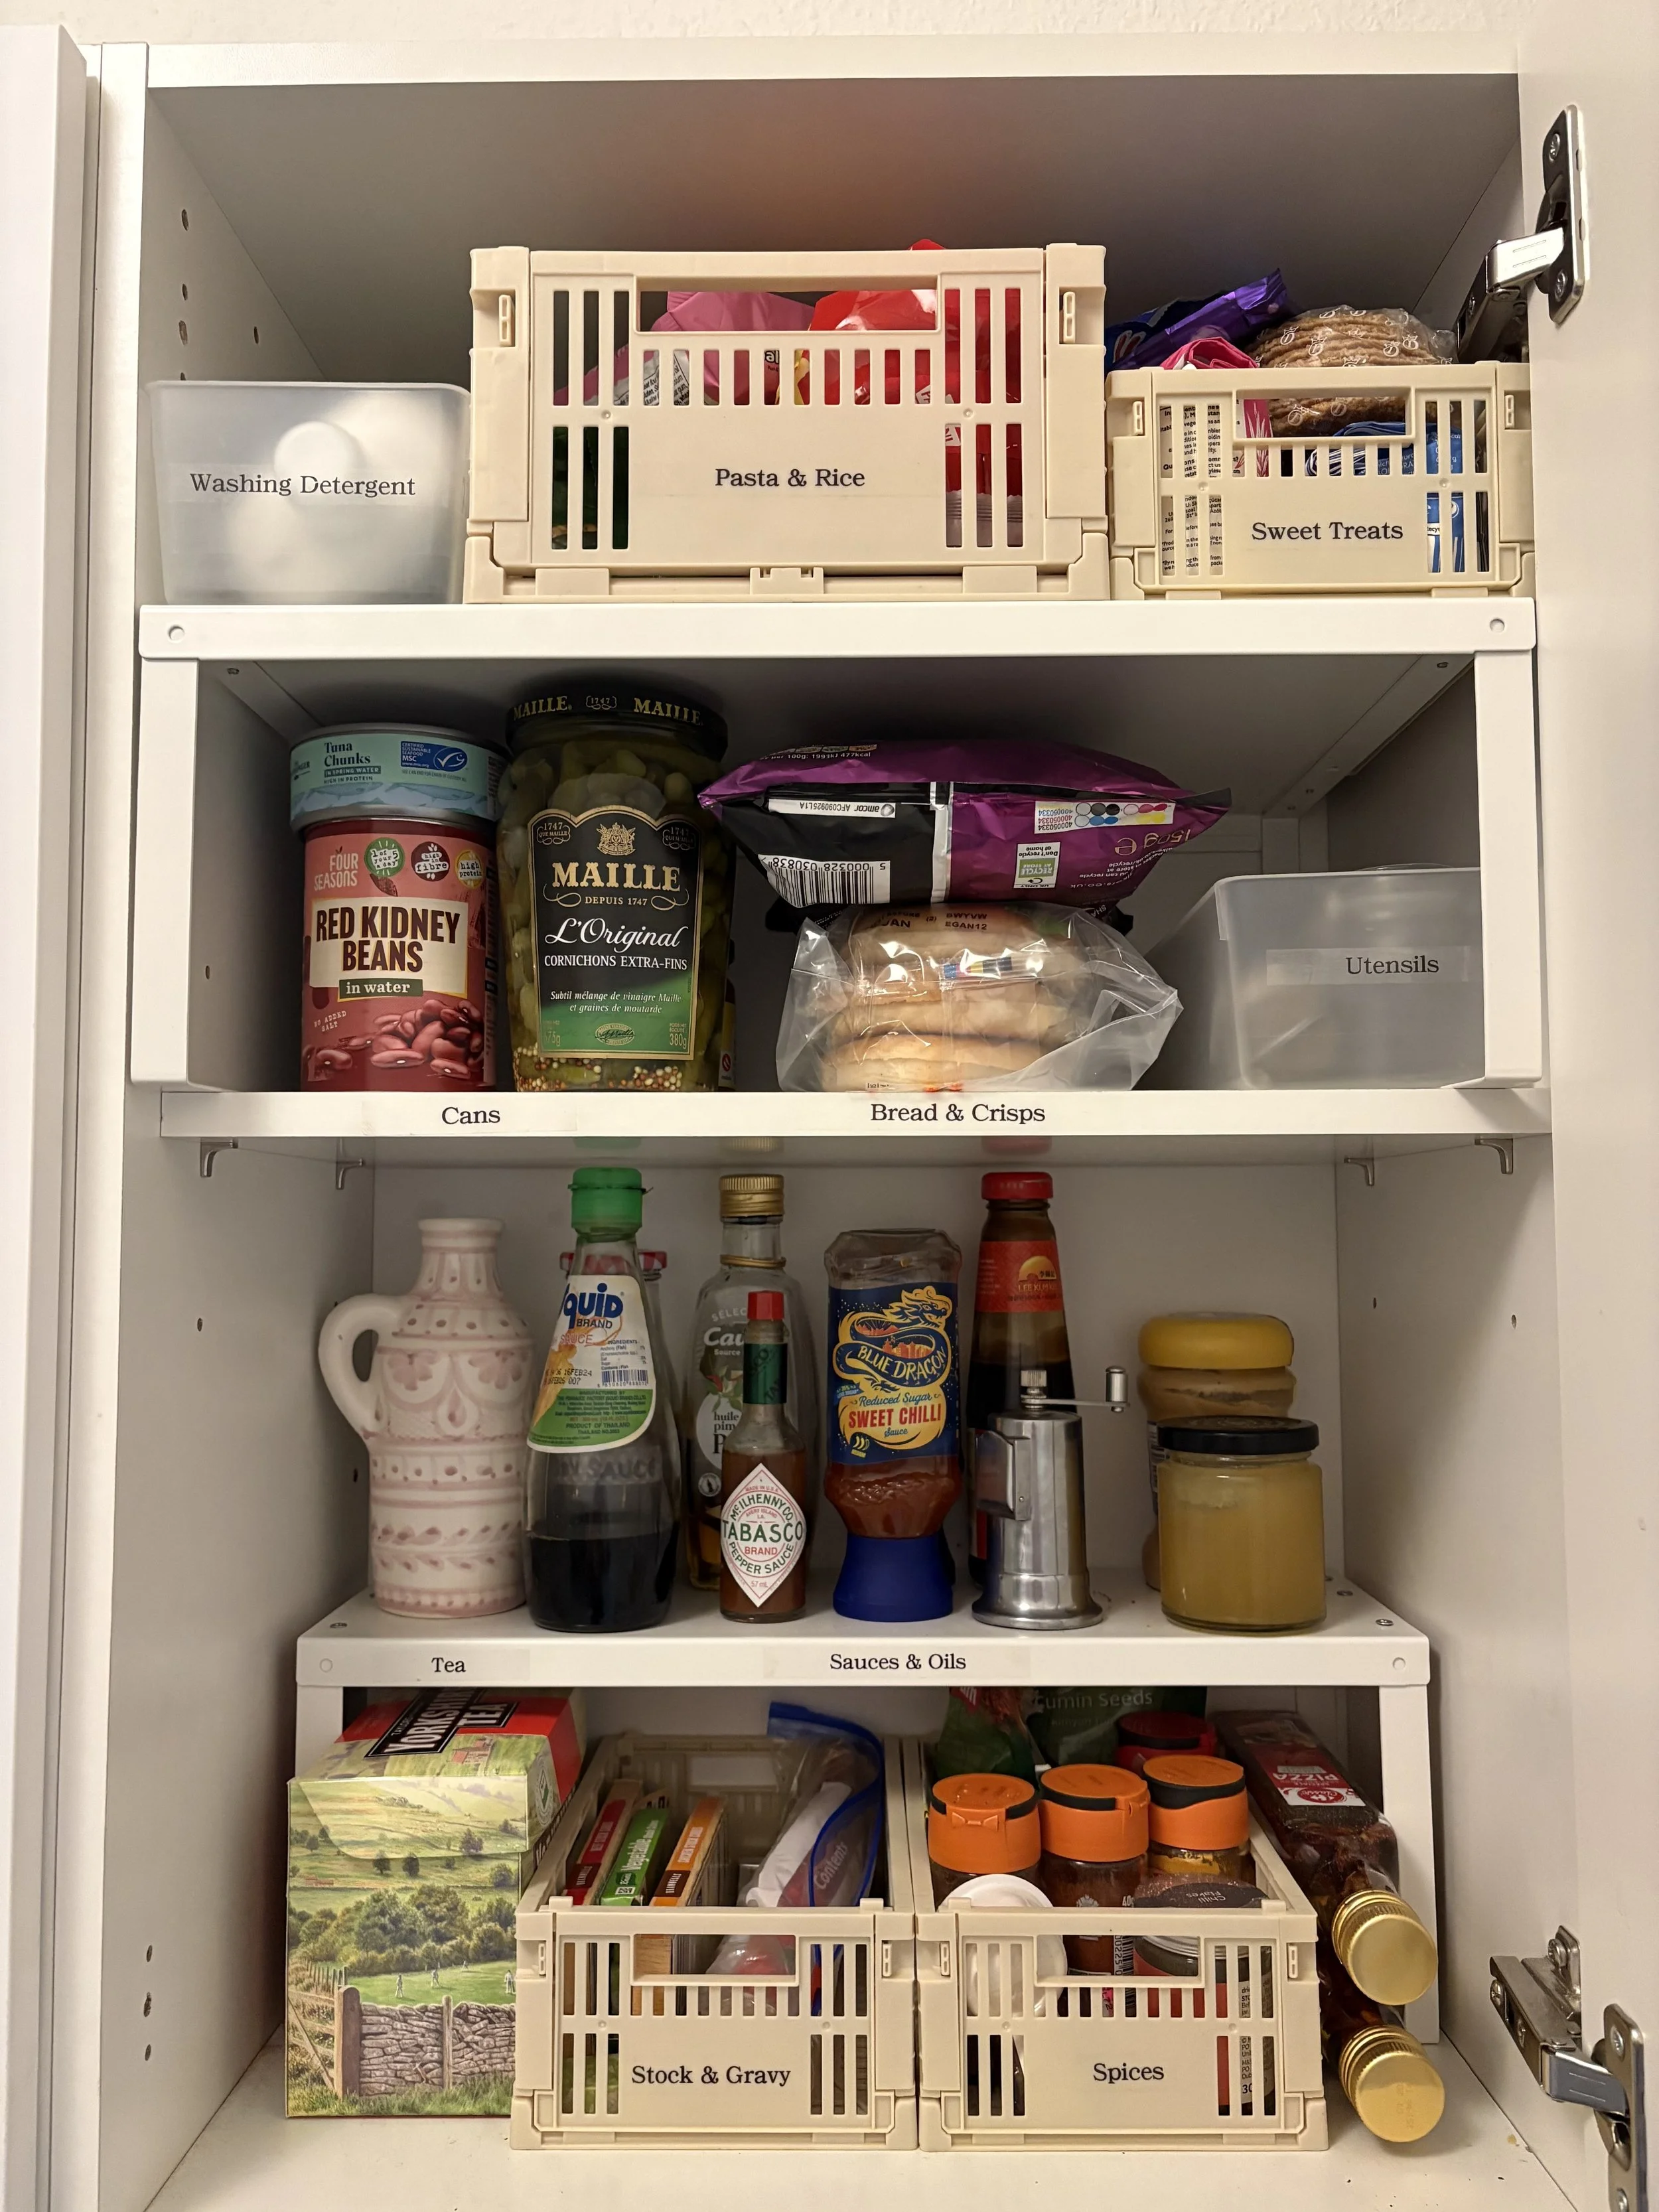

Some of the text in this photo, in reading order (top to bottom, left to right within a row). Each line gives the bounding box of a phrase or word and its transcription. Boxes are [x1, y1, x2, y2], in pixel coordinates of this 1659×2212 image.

[190, 473, 416, 497] Washing Detergent
[715, 469, 865, 487] Pasta & Rice
[1252, 522, 1403, 540] Sweet Treats
[514, 696, 568, 720] MAILLE
[633, 698, 700, 725] MAILLE
[324, 742, 352, 754] Tuna
[324, 754, 370, 767] Chunks
[800, 802, 850, 811] AFC090925L1A
[1039, 808, 1072, 817] 400050334
[543, 822, 563, 831] 1747
[1038, 814, 1072, 824] 400050334
[1038, 821, 1072, 830] 400050334
[1143, 828, 1191, 848] 150g
[330, 853, 358, 871] FOUR
[374, 855, 392, 864] your
[417, 863, 447, 871] fibre
[772, 857, 818, 871] 030838
[824, 863, 869, 872] 000328
[1021, 867, 1053, 876] RECYCLE
[314, 871, 357, 890] SEASONS
[552, 861, 680, 891] MAILLE
[585, 897, 623, 905] DEPUIS
[317, 906, 461, 944] RED KIDNEY
[545, 918, 689, 953] L'Original
[342, 940, 423, 972] BEANS
[544, 955, 687, 970] CORNICHONS EXTRA-FINS
[1346, 954, 1439, 975] Utensils
[346, 982, 410, 994] in water
[550, 991, 572, 1000] Subtil
[575, 992, 608, 1001] mélange
[623, 992, 656, 1003] vinaigre
[658, 994, 681, 1002] Maille
[579, 1004, 609, 1013] graines
[611, 1003, 622, 1012] de
[624, 1004, 662, 1013] moutarde
[324, 1011, 346, 1025] ADDED
[322, 1021, 338, 1032] SALT
[670, 1033, 687, 1049] 380g
[442, 1107, 500, 1124] Cans
[871, 1103, 1046, 1125] Bread & Crisps
[711, 1307, 747, 1322] SELEC
[577, 1319, 613, 1329] BRAND
[560, 1335, 593, 1345] SAUCE
[857, 1345, 947, 1382] BLUE DRAGON
[859, 1392, 932, 1407] Reduced Sugar
[714, 1412, 739, 1421] huile
[849, 1403, 942, 1428] SWEET CHILLI
[884, 1428, 908, 1438] Sauce
[746, 1509, 777, 1518] AVERY ISLAND
[783, 1507, 794, 1522] CO.
[722, 1520, 802, 1543] TABASCO
[729, 1542, 794, 1574] PEPPER SAUCE
[431, 1657, 467, 1672] Tea
[830, 1653, 966, 1670] Sauces & Oils
[384, 1688, 475, 1753] YORKSHIR
[457, 1702, 507, 1726] TEA
[620, 1838, 652, 1872] Vegetable
[813, 1840, 849, 1890] Contents
[632, 2065, 791, 2087] Stock & Gravy
[1093, 2063, 1165, 2084] Spices
